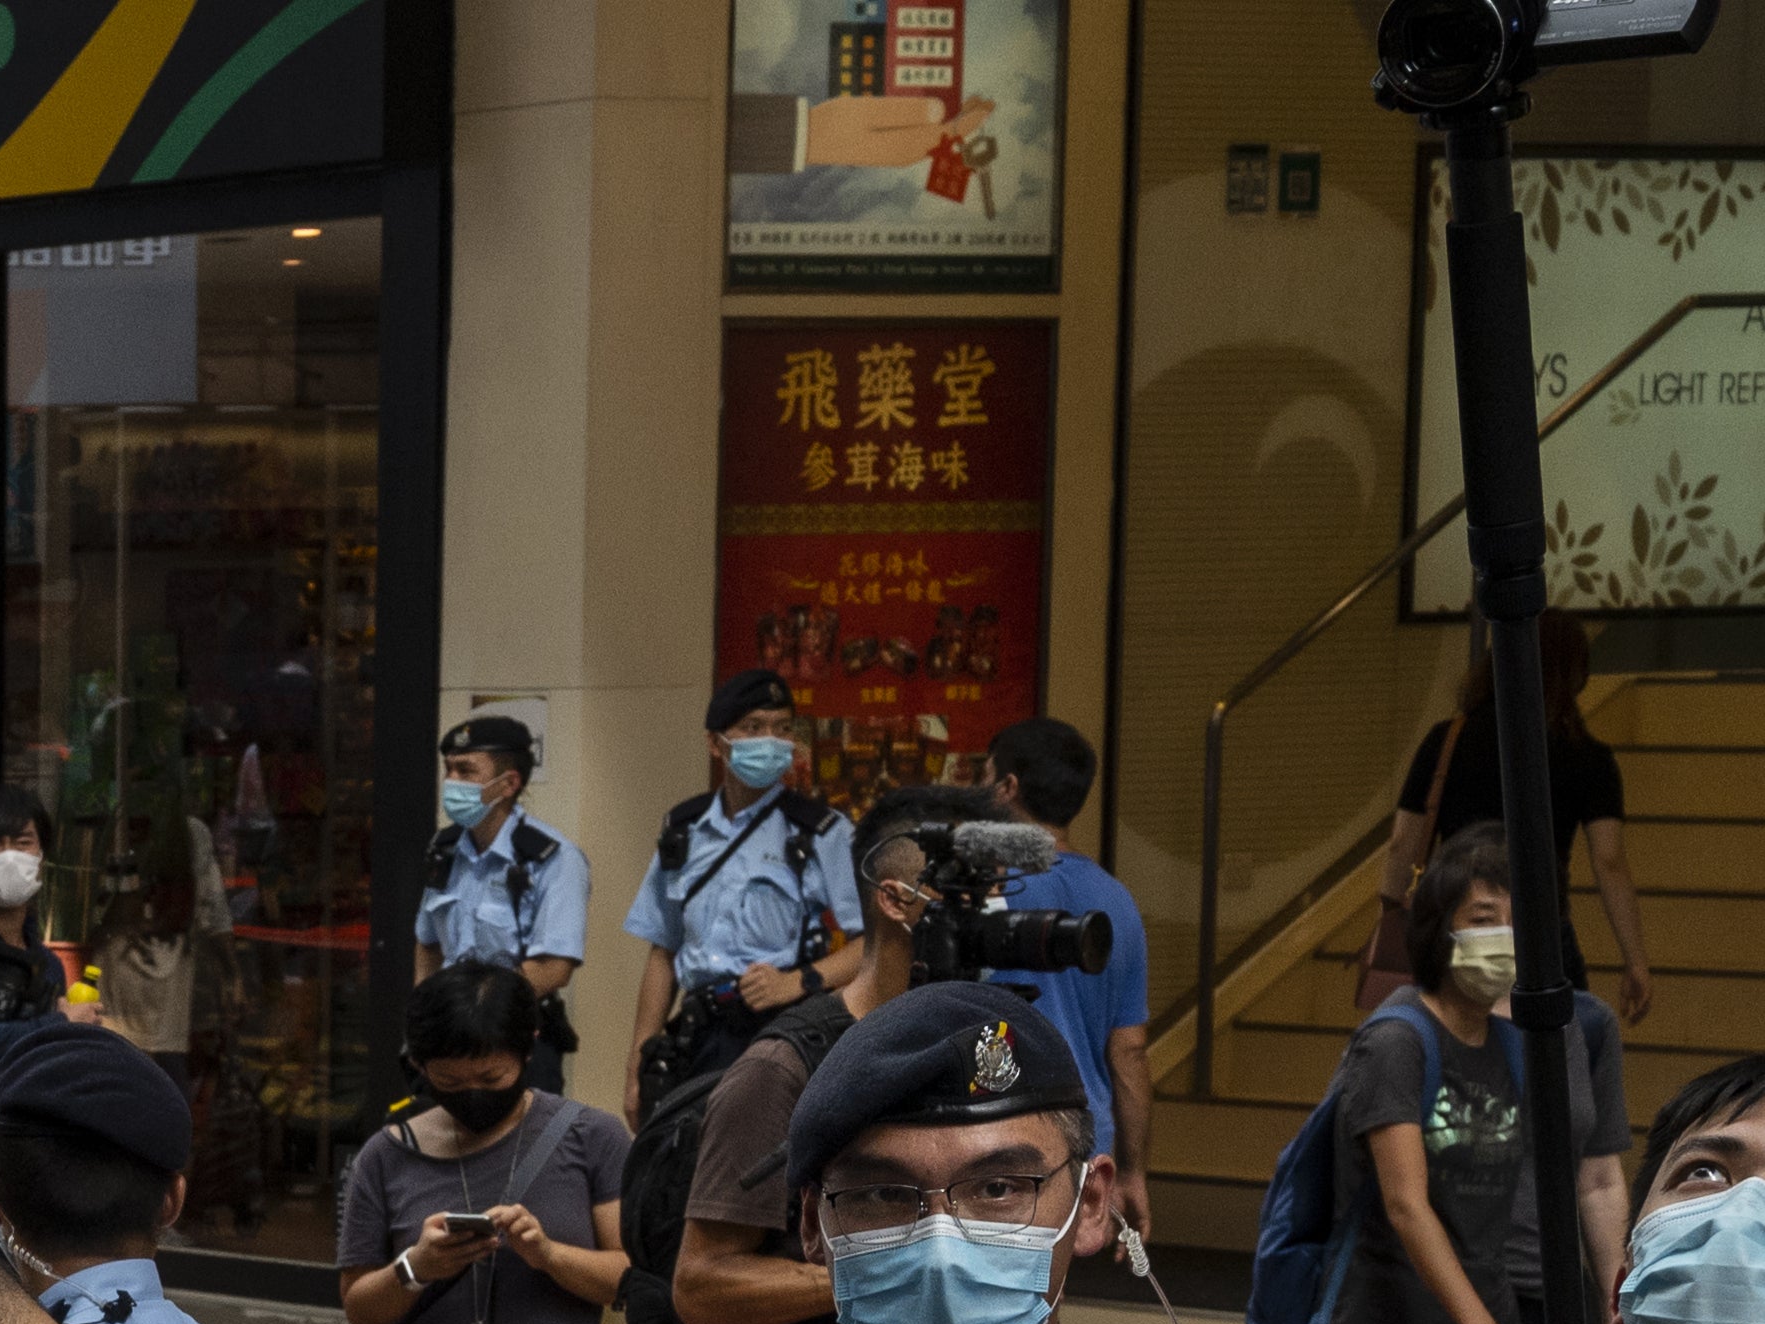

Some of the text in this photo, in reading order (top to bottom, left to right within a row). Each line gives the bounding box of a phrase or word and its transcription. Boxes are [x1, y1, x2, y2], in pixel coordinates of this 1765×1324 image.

[776, 343, 995, 431] 飛藥堂
[1534, 353, 1567, 398] YS
[1640, 371, 1707, 406] LIGHT
